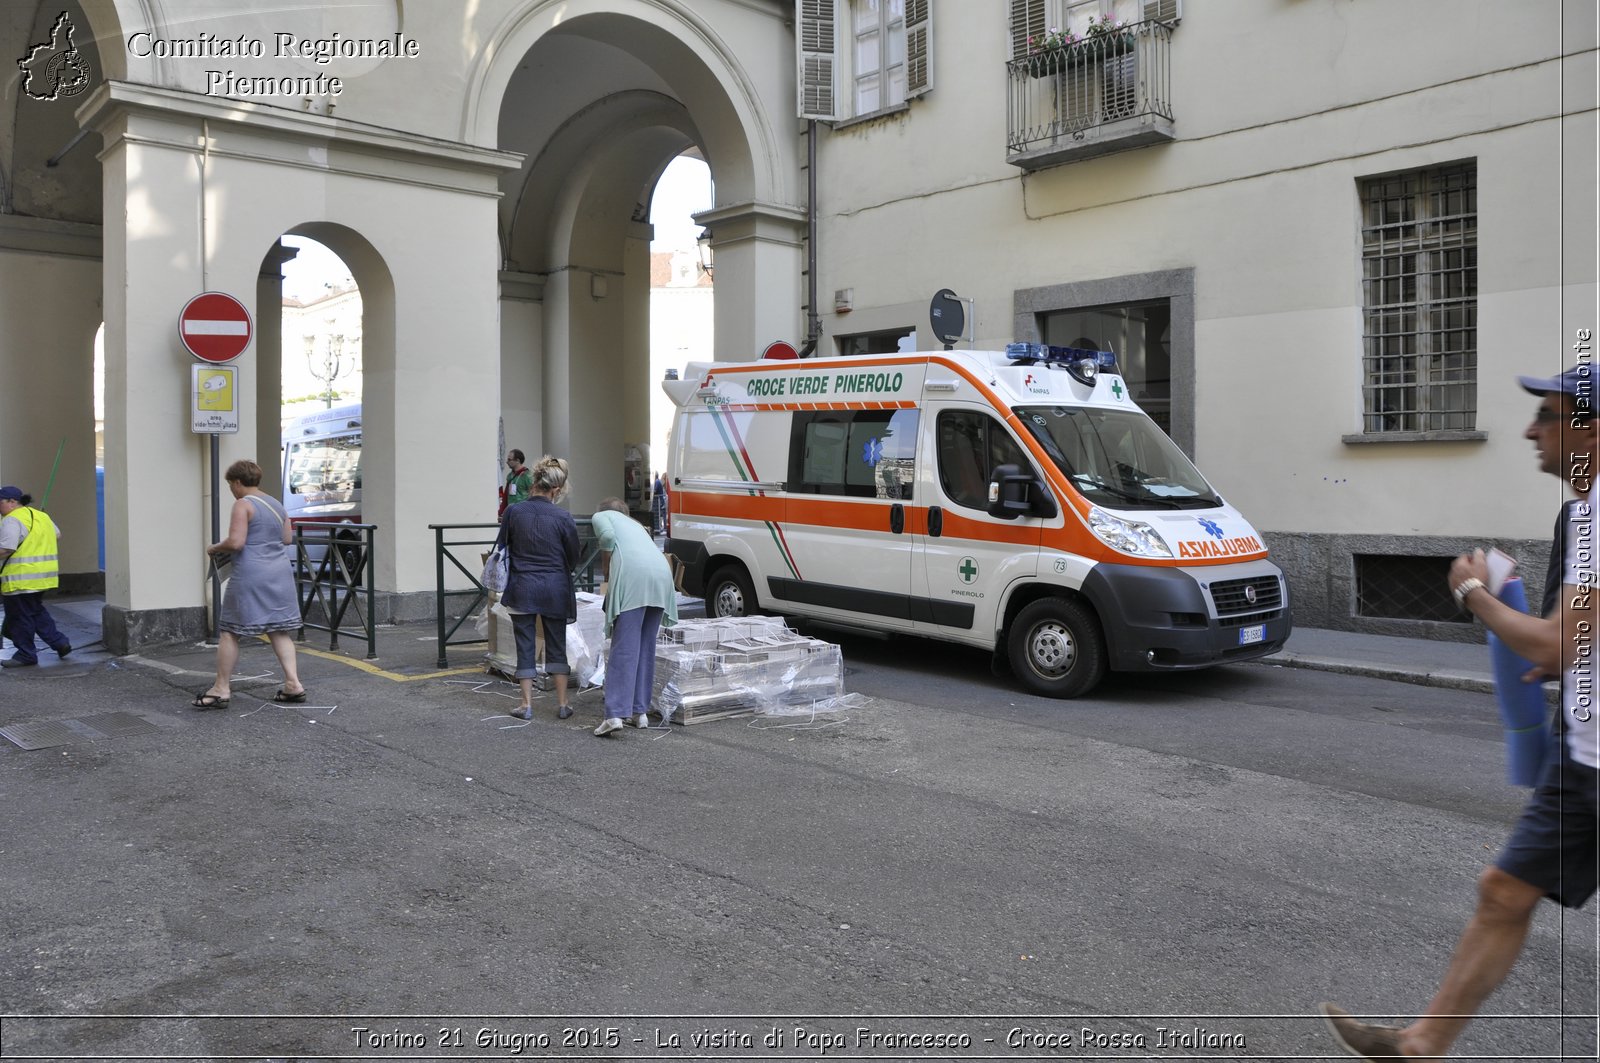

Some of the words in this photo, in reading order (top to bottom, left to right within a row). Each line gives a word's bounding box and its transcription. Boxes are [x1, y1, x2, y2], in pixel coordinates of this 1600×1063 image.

[747, 377, 786, 397] CROCE
[789, 375, 829, 395] VERDE
[834, 372, 903, 394] PINEROLO
[707, 396, 731, 405] ANPAS
[1056, 561, 1066, 571] 73
[951, 589, 985, 599] PINEROLO
